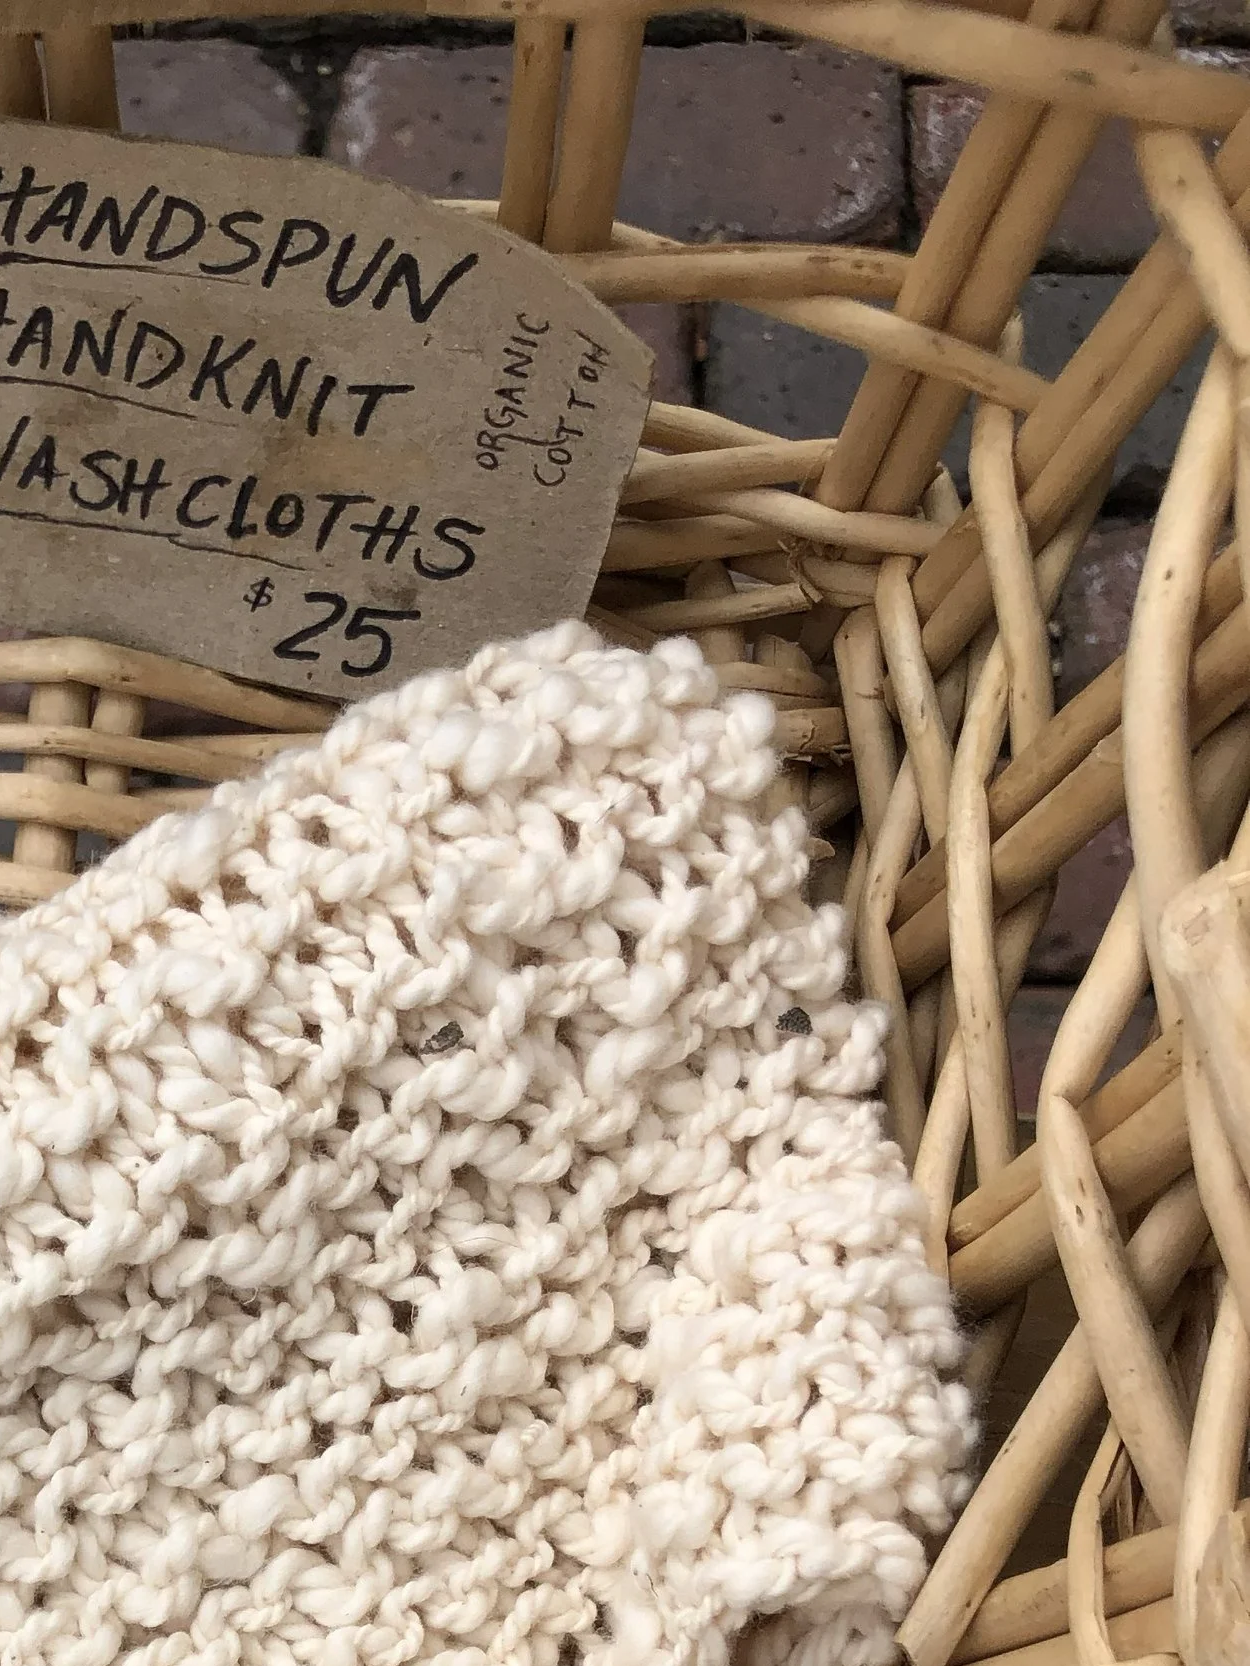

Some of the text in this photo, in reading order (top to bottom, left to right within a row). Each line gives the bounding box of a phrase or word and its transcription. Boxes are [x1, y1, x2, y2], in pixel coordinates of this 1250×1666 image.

[476, 312, 551, 471] ORGANIC
[534, 329, 611, 487] COTTON
[243, 577, 420, 677] $25
